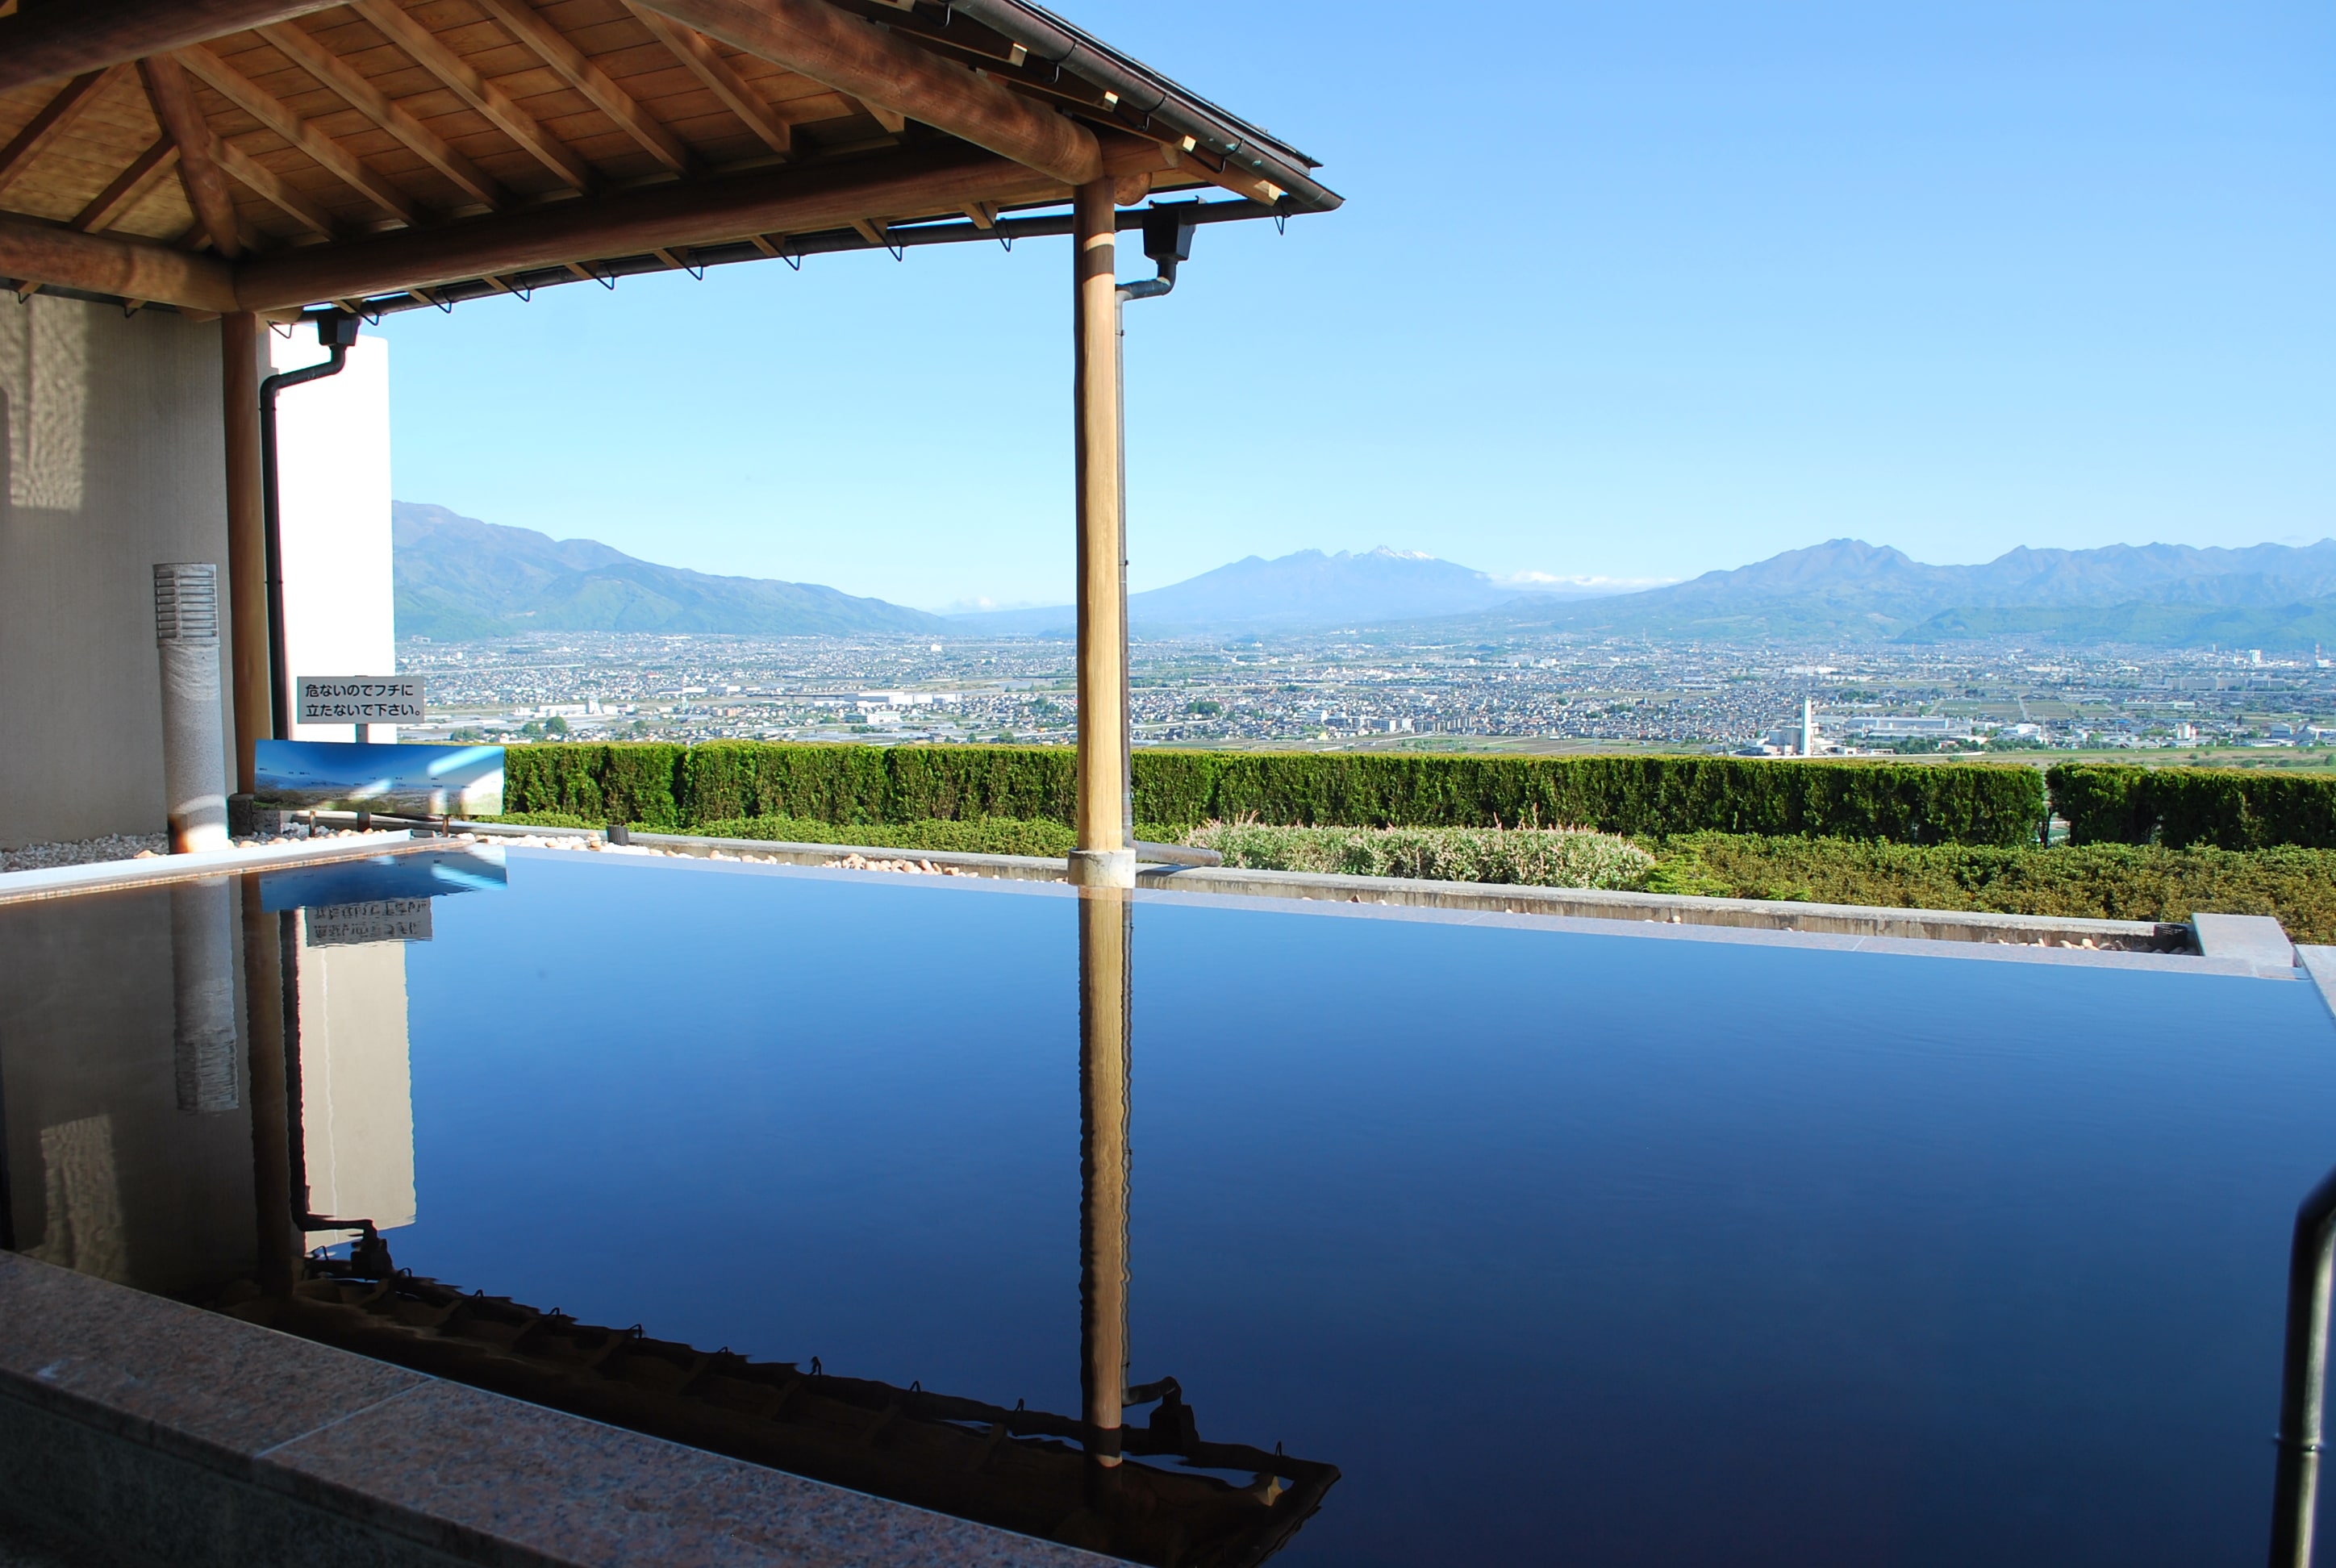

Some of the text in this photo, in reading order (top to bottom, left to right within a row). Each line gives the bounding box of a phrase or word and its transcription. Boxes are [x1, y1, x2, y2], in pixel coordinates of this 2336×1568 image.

[306, 684, 413, 697] 危ないのでフチに
[306, 703, 420, 716] 立たないで下さい。
